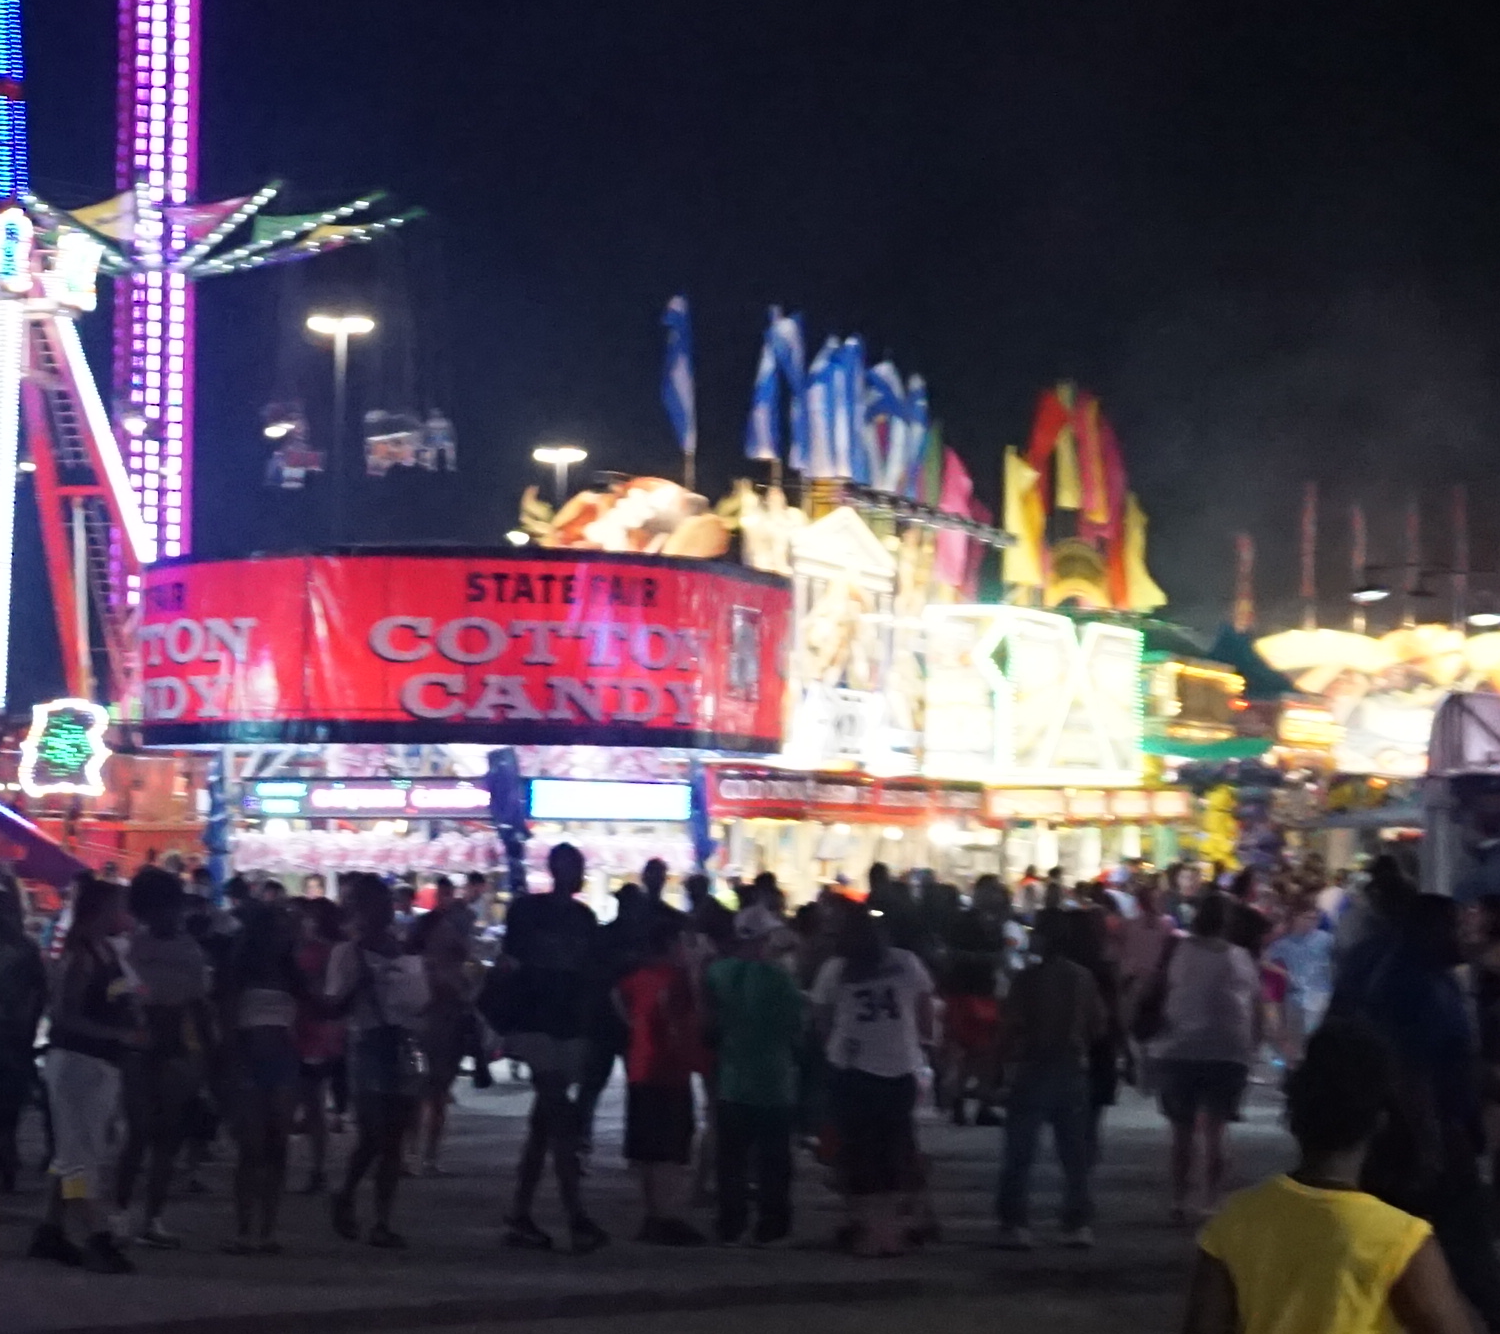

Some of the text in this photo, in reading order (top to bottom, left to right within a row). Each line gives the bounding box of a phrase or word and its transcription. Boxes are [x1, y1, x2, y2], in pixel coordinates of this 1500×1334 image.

[465, 571, 659, 608] STATE FAIR
[137, 615, 257, 668] TON
[368, 614, 712, 673] COTTON
[400, 673, 699, 725] CANDY
